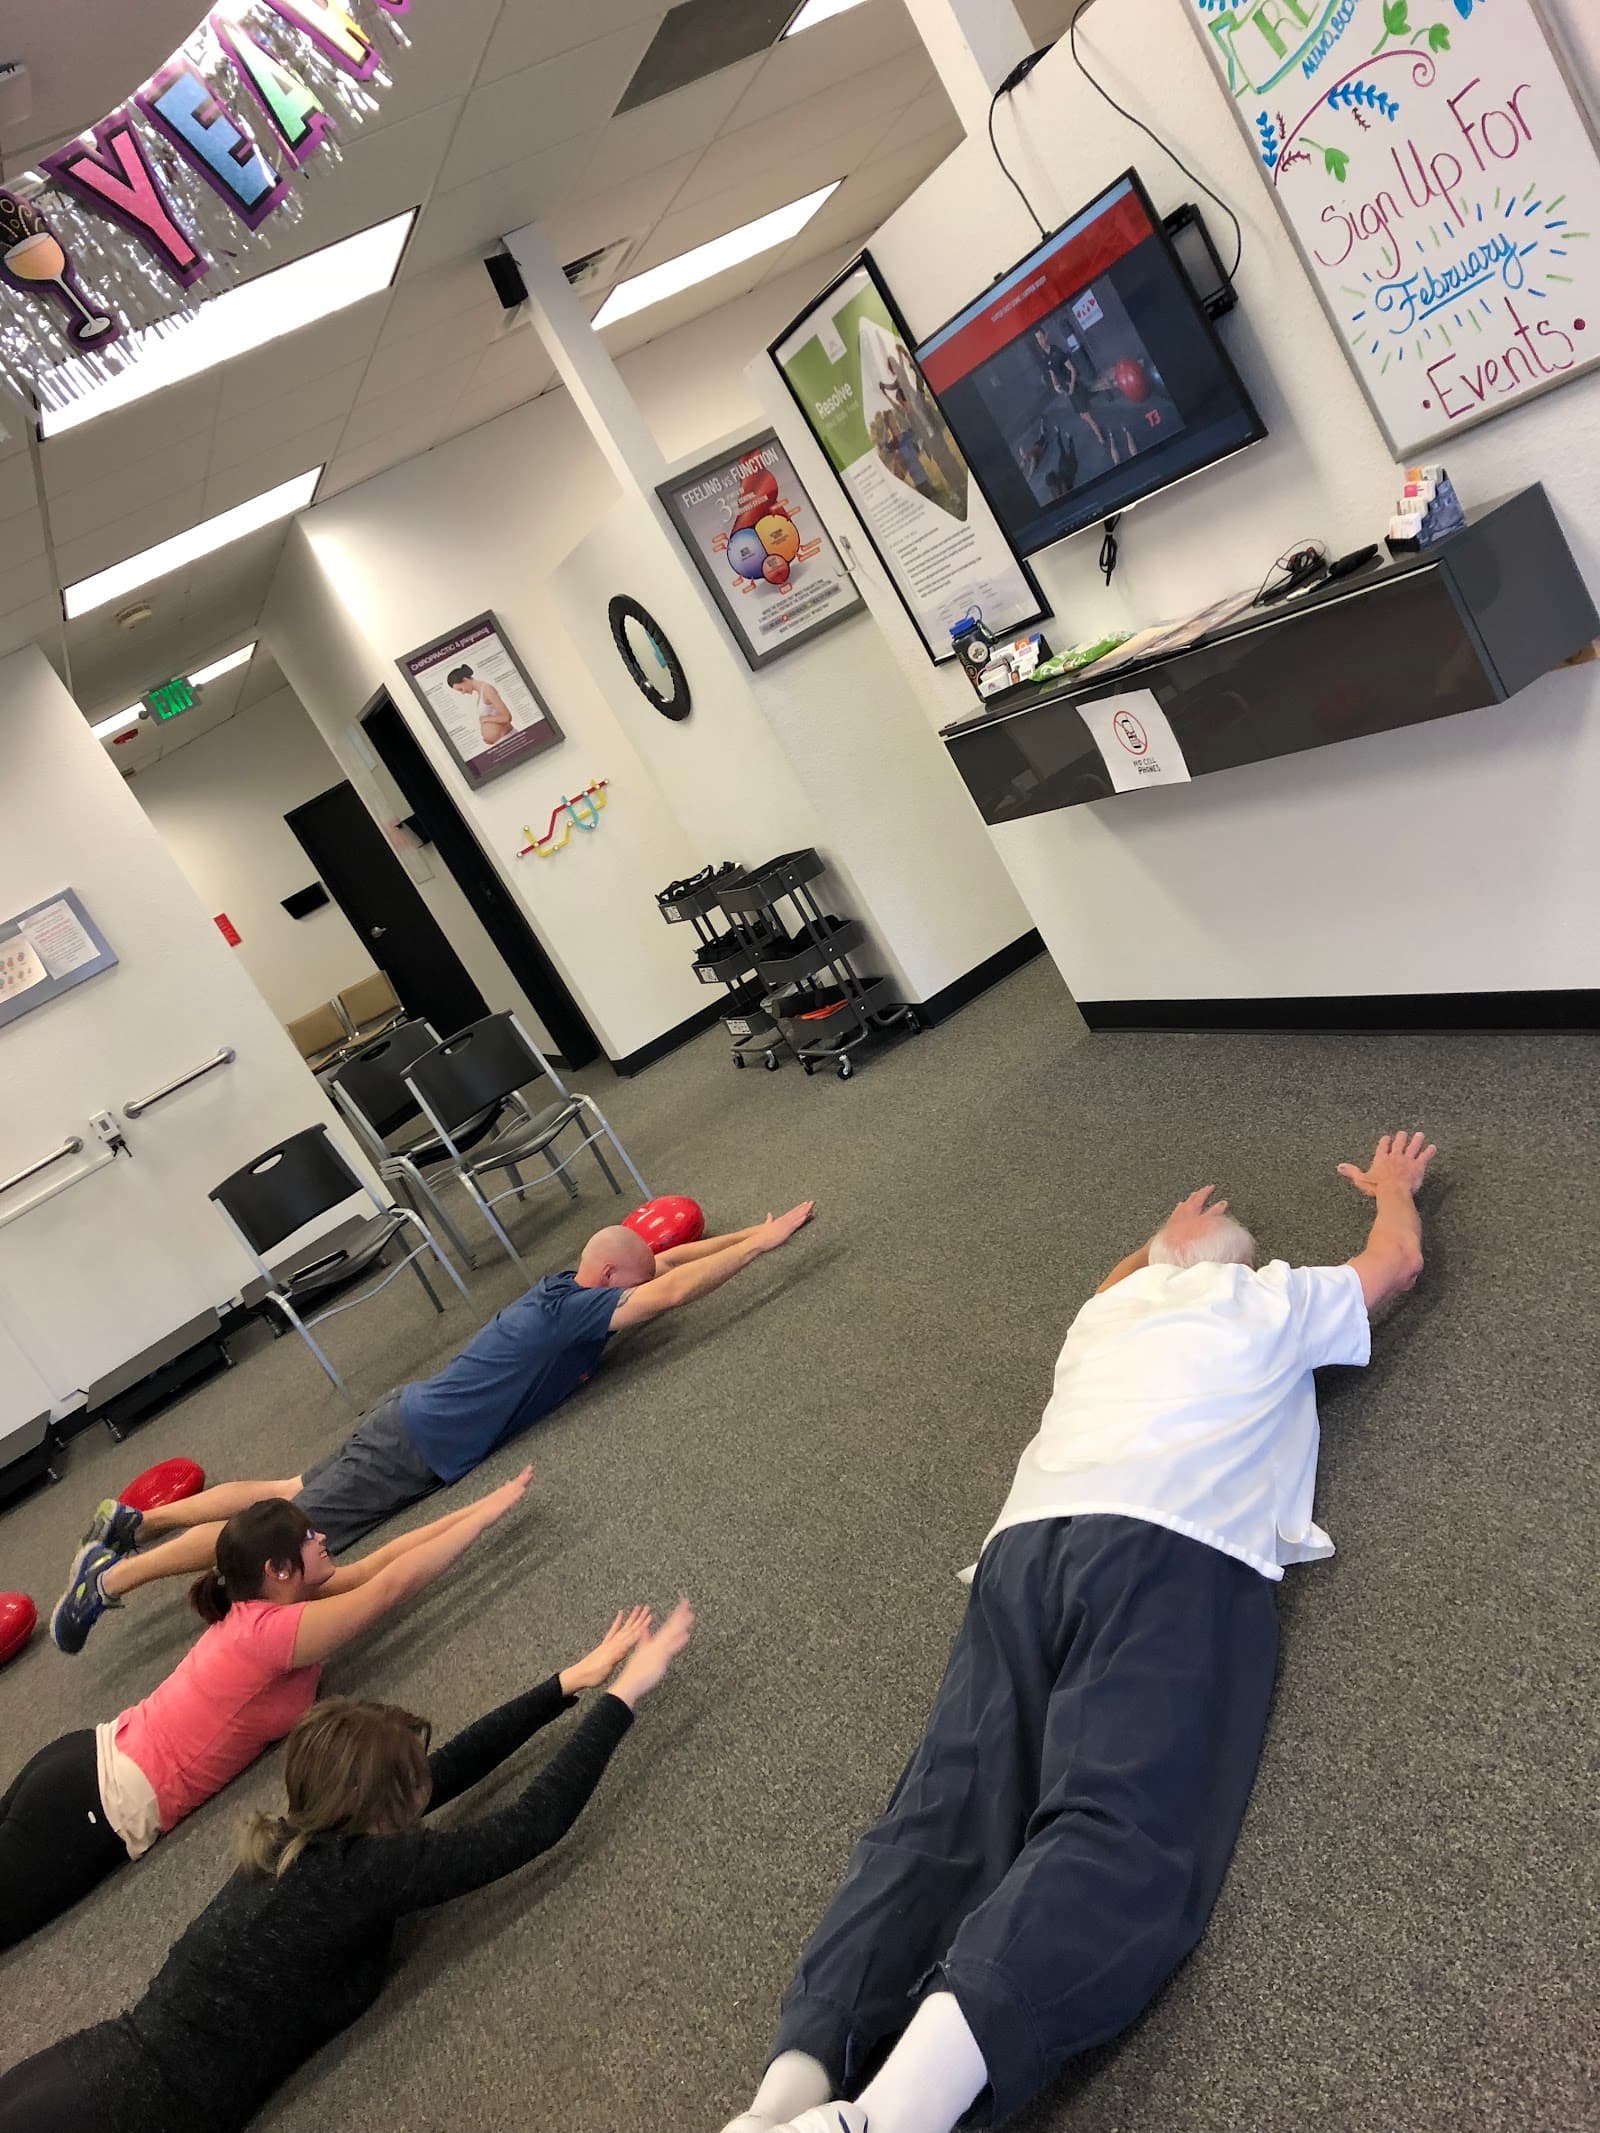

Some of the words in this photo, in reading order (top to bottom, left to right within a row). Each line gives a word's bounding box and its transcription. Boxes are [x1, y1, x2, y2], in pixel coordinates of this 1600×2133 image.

[1313, 190, 1402, 280] Sign
[1390, 138, 1466, 229] Up
[1446, 77, 1532, 171] For
[1375, 233, 1525, 334] February
[815, 383, 853, 420] Resolve
[681, 478, 722, 509] FEELING
[730, 447, 780, 482] FUNCTION
[149, 679, 193, 720] EXIT
[1133, 759, 1143, 767] NO
[1143, 757, 1157, 766] CELL
[1138, 764, 1161, 774] PHONES
